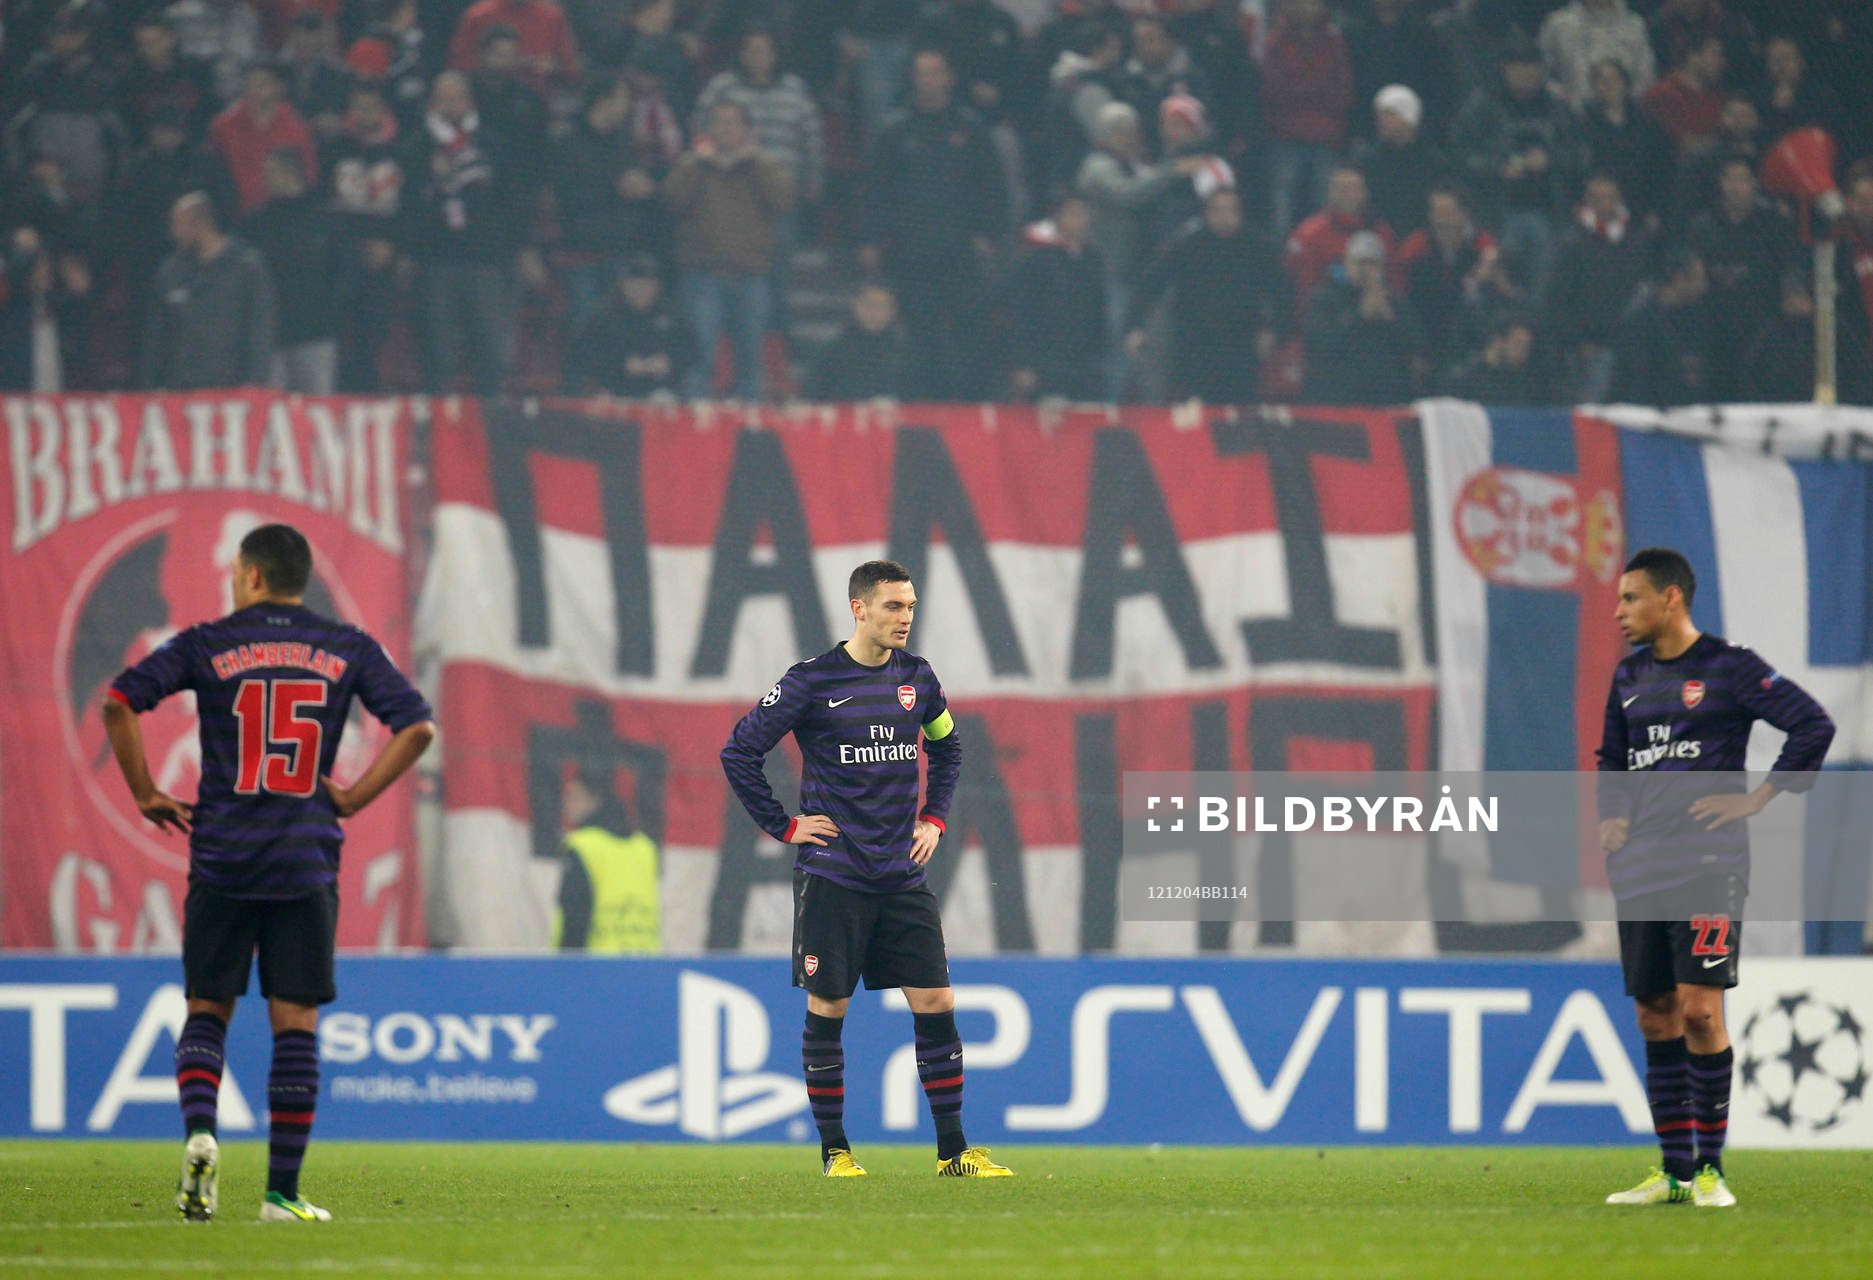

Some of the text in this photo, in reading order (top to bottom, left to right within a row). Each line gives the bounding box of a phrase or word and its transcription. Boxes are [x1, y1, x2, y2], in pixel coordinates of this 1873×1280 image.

[8, 397, 404, 553] BRAHAMI
[478, 397, 1439, 684] ΠΑΛΑΙ
[211, 641, 348, 684] CHAMBERLAIN
[233, 679, 327, 796] 15
[839, 742, 918, 764] Emirates
[869, 724, 895, 742] Fly
[1647, 724, 1672, 743] Fly
[1689, 914, 1730, 956] 22
[319, 1011, 558, 1064] SONY
